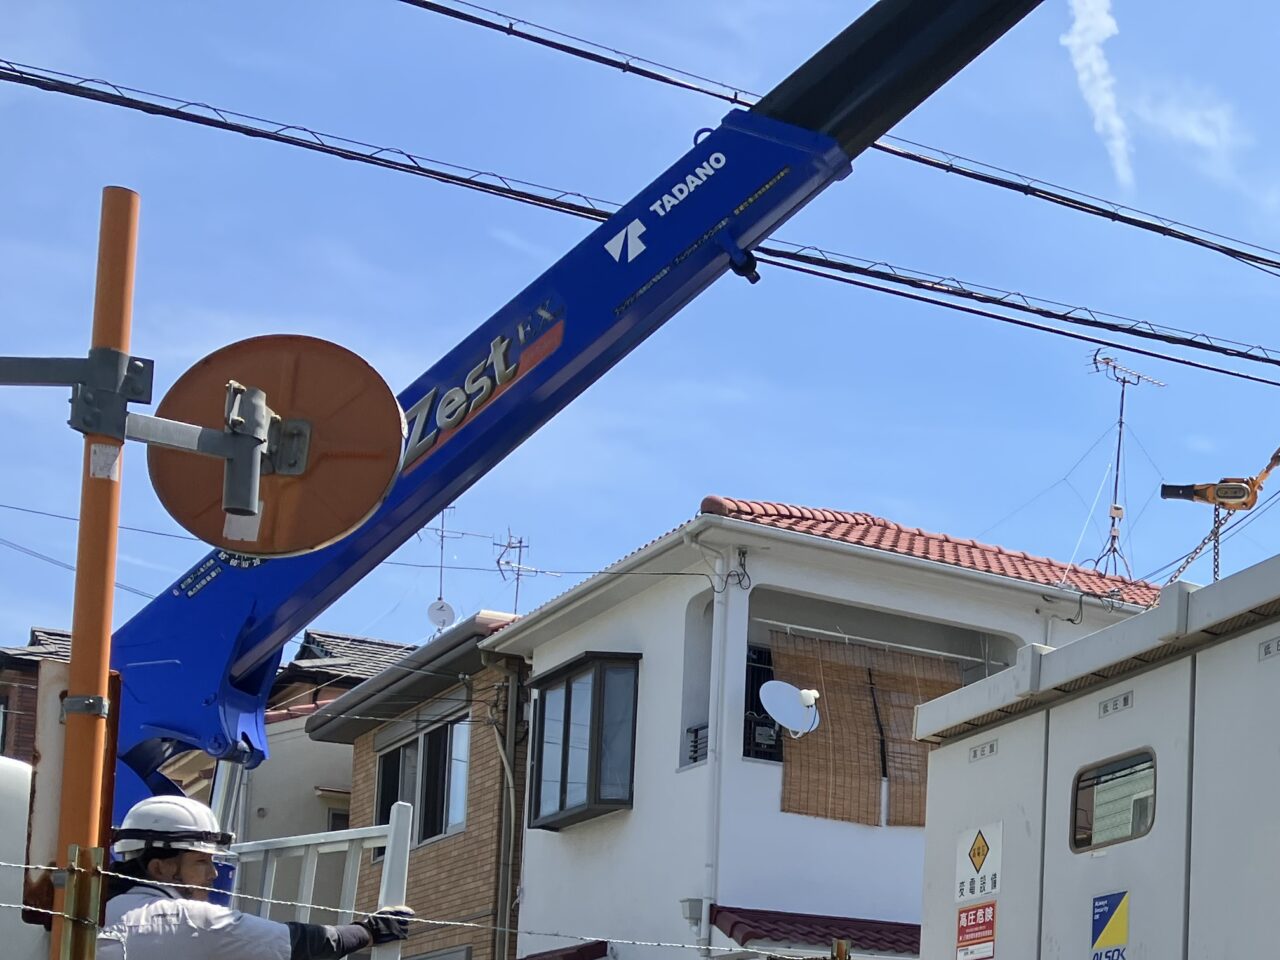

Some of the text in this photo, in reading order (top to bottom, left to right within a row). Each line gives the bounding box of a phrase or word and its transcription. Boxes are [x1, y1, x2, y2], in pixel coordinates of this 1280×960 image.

[649, 152, 726, 217] TADANO
[403, 335, 519, 469] Zest
[958, 873, 998, 898] 変電設備
[959, 907, 994, 928] 高圧危険
